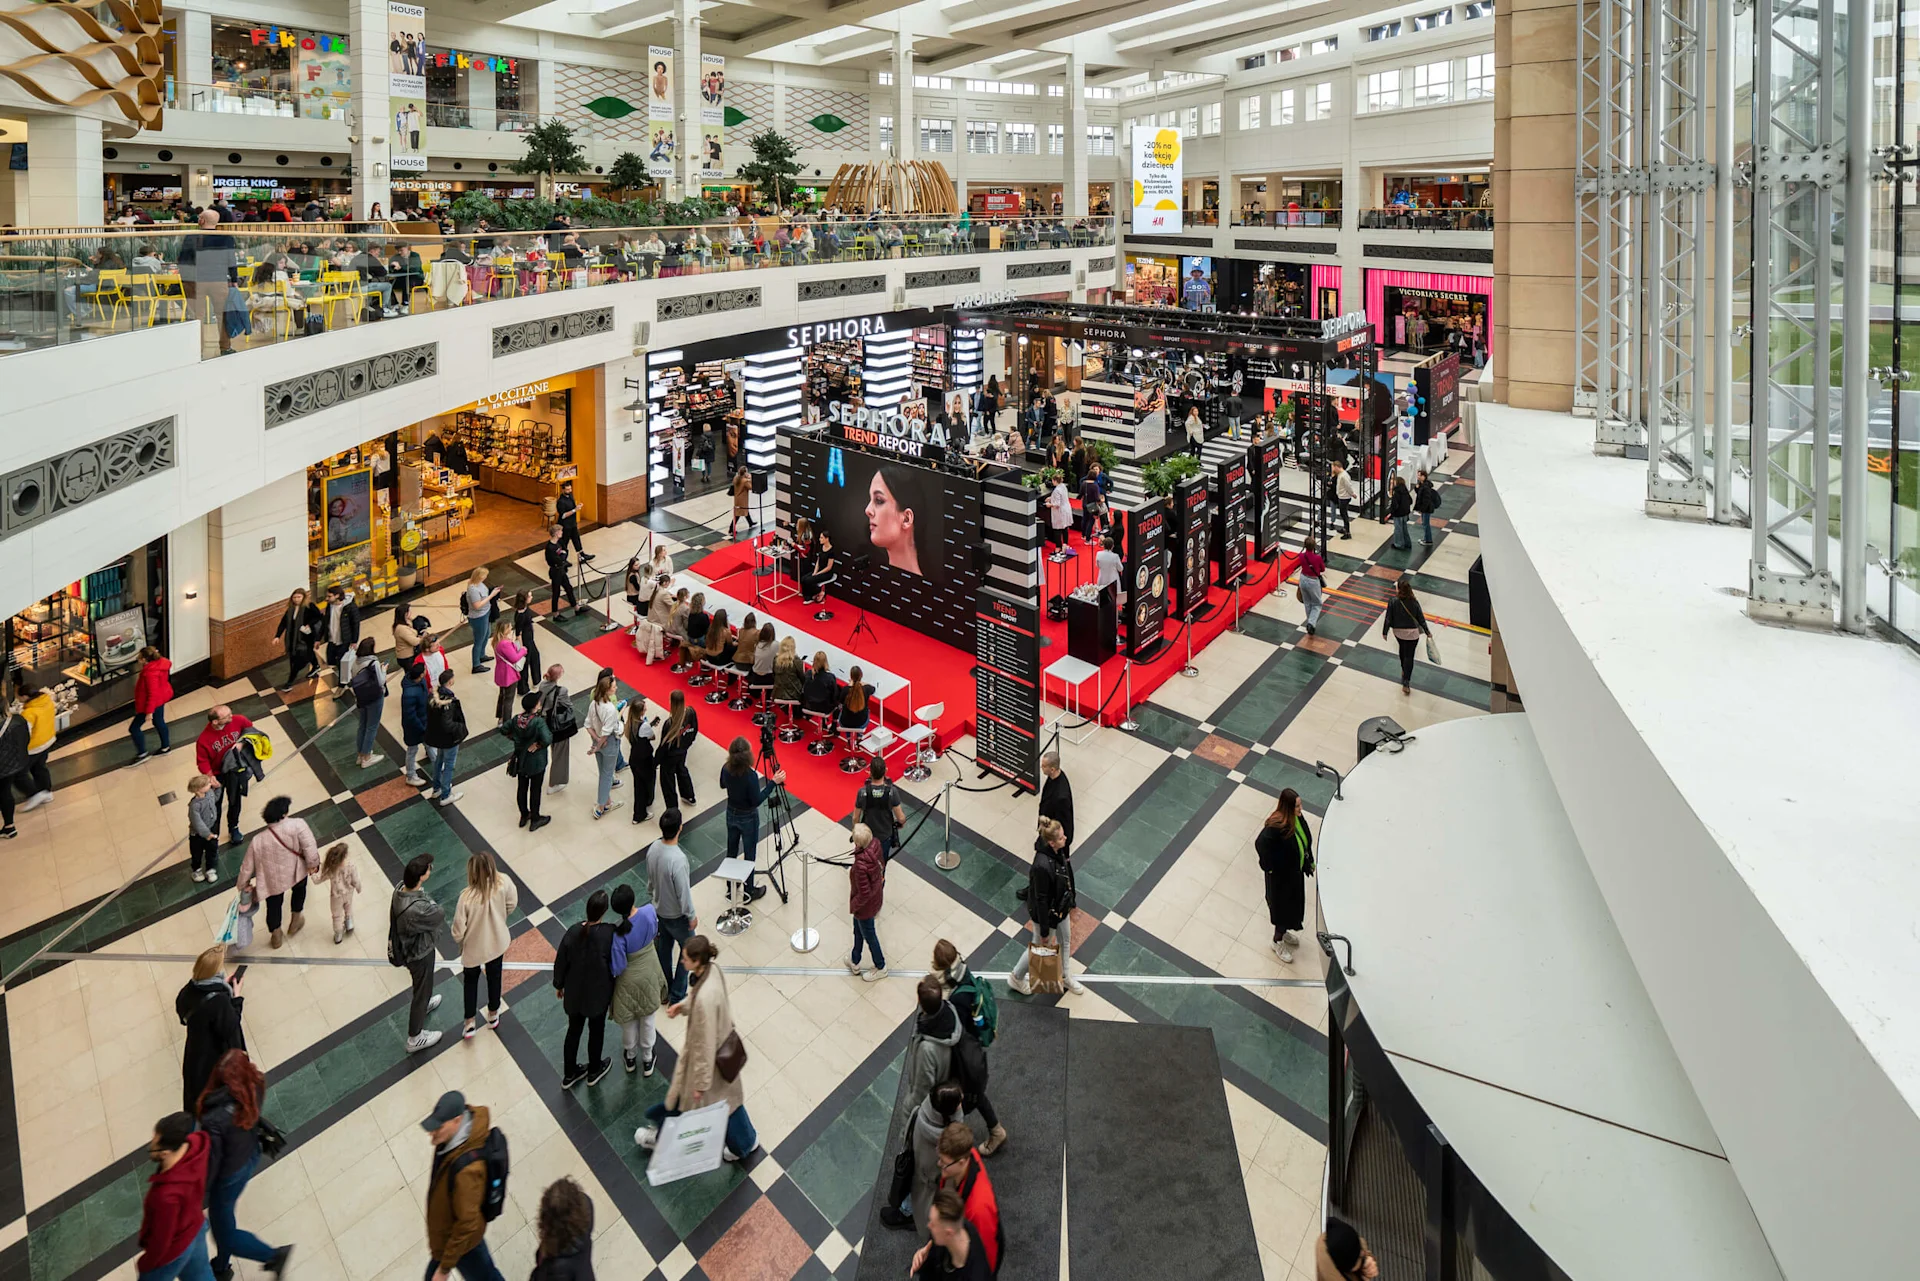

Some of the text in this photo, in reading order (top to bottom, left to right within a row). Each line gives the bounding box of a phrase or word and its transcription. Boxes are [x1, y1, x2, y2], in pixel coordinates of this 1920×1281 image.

[1144, 141, 1162, 149] -20%
[1144, 151, 1171, 160] kolekcję
[1142, 162, 1174, 170] dziecięcą
[213, 178, 278, 188] URGER KING
[390, 181, 452, 190] McDonald's
[555, 182, 579, 193] KFC
[1399, 288, 1468, 301] VICTORIA'S SECRET
[1321, 309, 1368, 339] SEPHORA
[787, 315, 886, 348] SEPHORA
[1083, 327, 1126, 339] SEPHORA
[1350, 331, 1367, 346] REPORT
[1244, 342, 1263, 350] REPORT
[477, 382, 549, 406] LOCCITANE
[1313, 384, 1337, 395] CRE
[503, 395, 537, 407] PROVENCE
[1091, 405, 1123, 419] TREND
[828, 400, 947, 448] SEPHORA
[843, 425, 924, 457] TREND REPORT
[1263, 448, 1279, 464] TREND
[1226, 466, 1245, 483] TREND
[1186, 489, 1207, 508] TREND
[1137, 513, 1163, 535] TREND
[1146, 525, 1163, 540] REPORT
[992, 601, 1018, 617] TREND
[1000, 612, 1018, 623] REPORT
